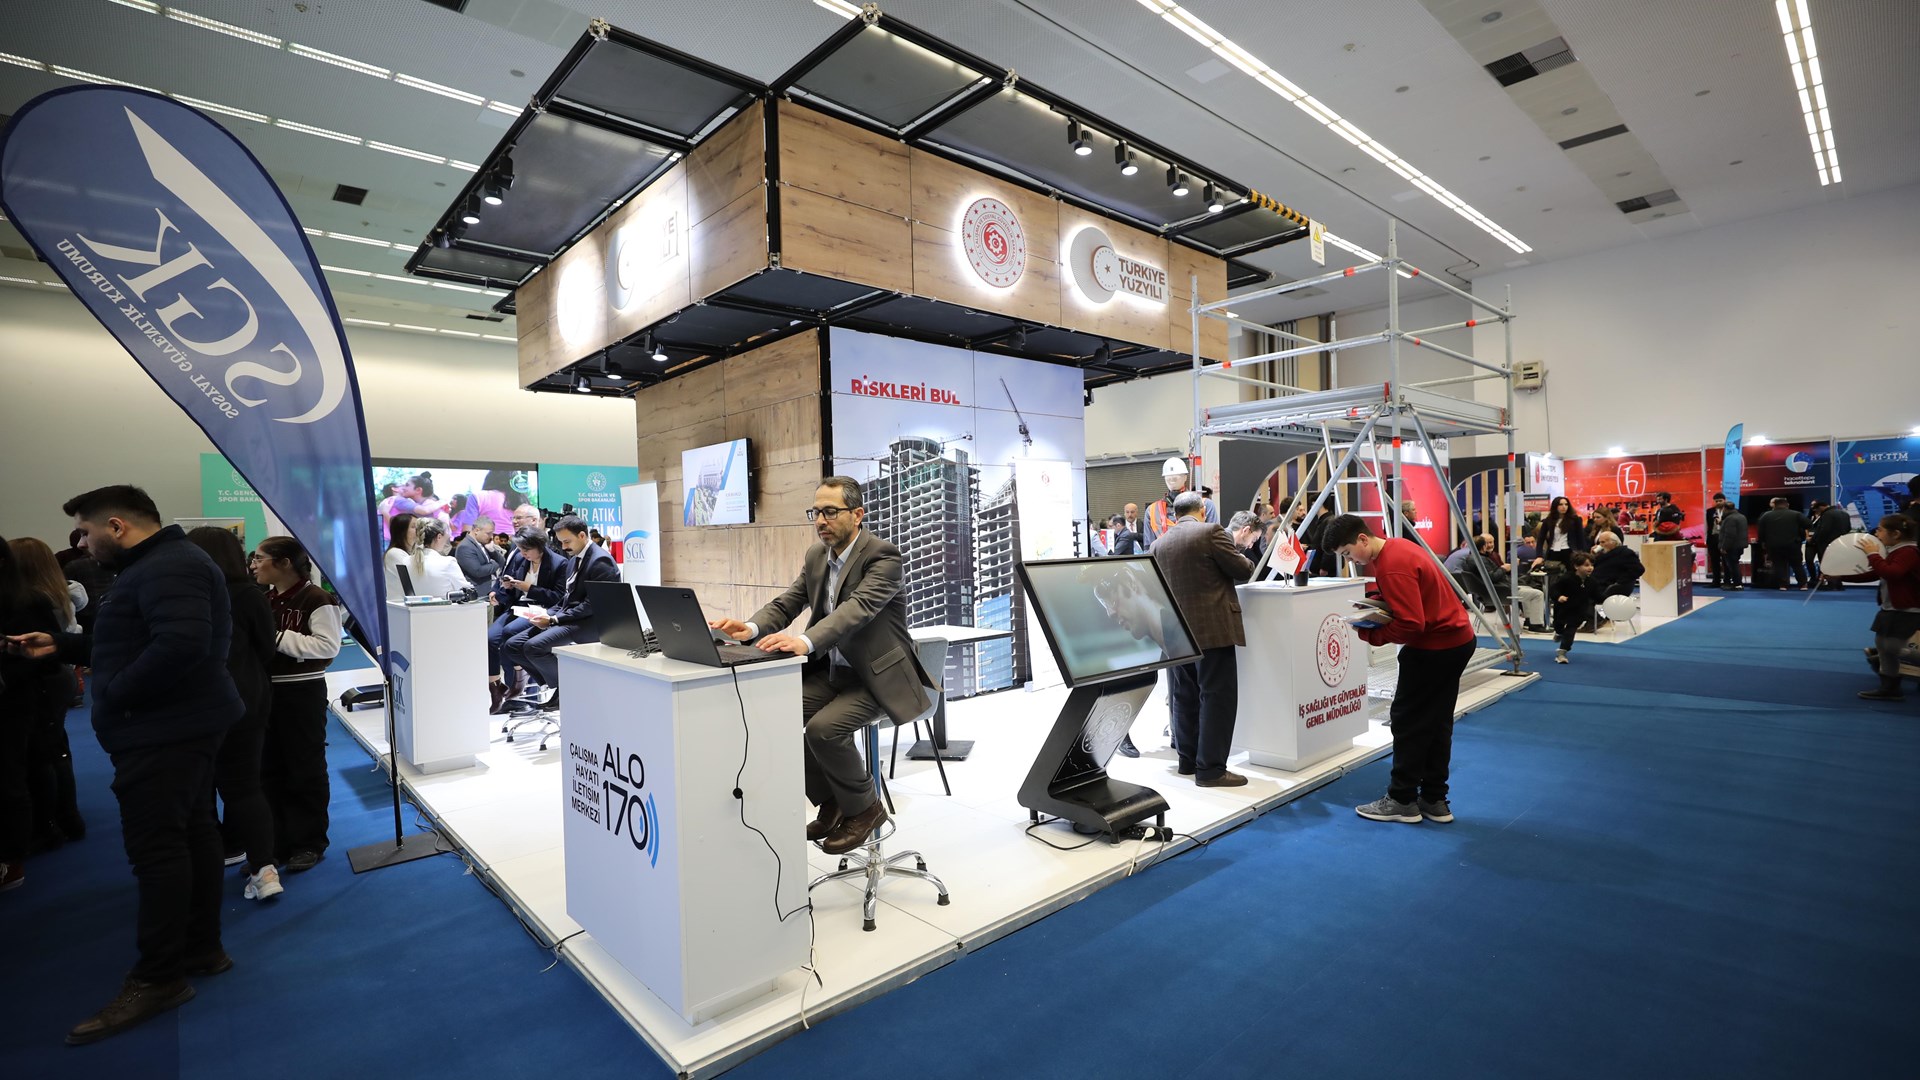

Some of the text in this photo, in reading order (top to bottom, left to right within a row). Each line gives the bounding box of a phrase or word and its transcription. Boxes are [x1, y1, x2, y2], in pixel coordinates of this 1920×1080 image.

[1118, 257, 1166, 286] TÜRKİYE
[1118, 274, 1163, 300] YÜZYILI
[850, 375, 960, 405] RİSKLERİ BUL
[233, 489, 258, 497] GENÇ
[592, 507, 615, 522] ATIK
[626, 542, 645, 560] SGK
[393, 673, 405, 707] GK
[1298, 683, 1366, 719] İŞ SAĞLIĞI VE GÜVENLİĞİ
[1306, 700, 1362, 729] GENEL MÜDÜRLÜĞÜ
[569, 742, 599, 769] ÇALIŞMA
[602, 742, 645, 790] ALO
[575, 763, 600, 786] HAYATI
[572, 775, 601, 806] İLETİŞİM
[571, 796, 601, 825] MERKEZİ
[602, 780, 649, 851] 170
